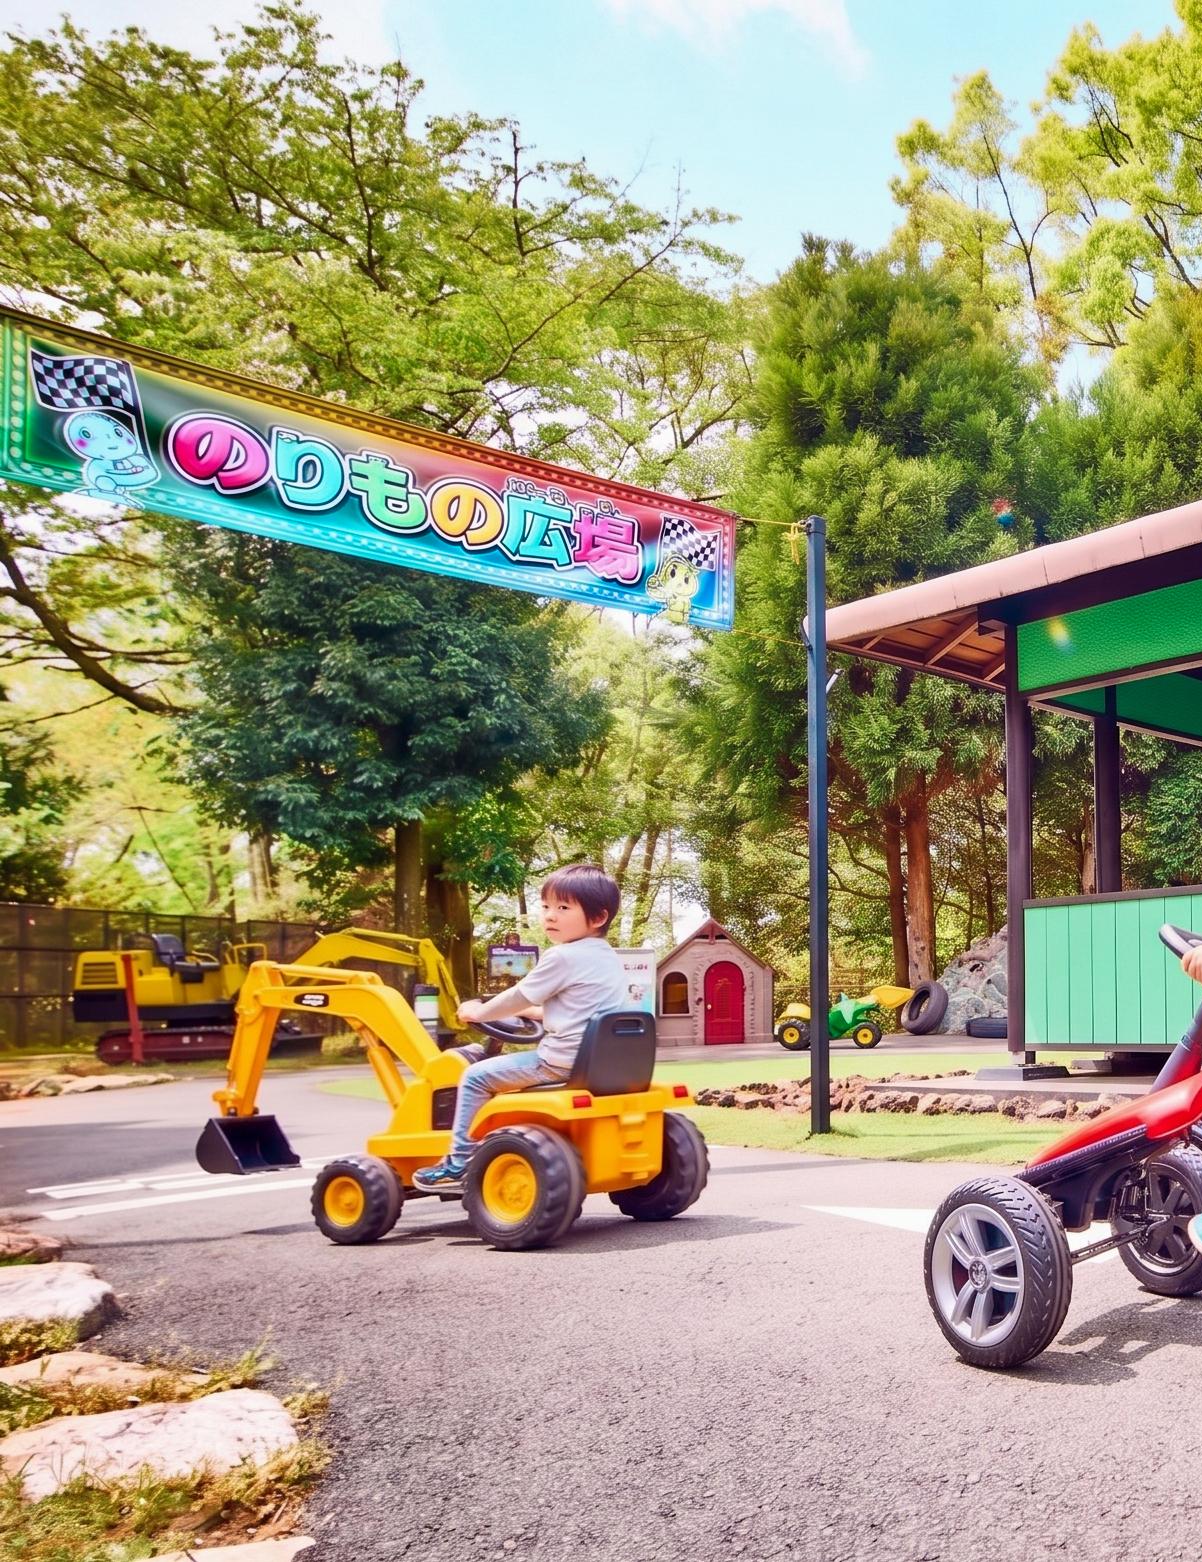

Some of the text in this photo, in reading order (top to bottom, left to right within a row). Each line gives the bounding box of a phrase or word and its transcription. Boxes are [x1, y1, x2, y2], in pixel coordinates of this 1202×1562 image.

[168, 413, 642, 583] のりもの広場
